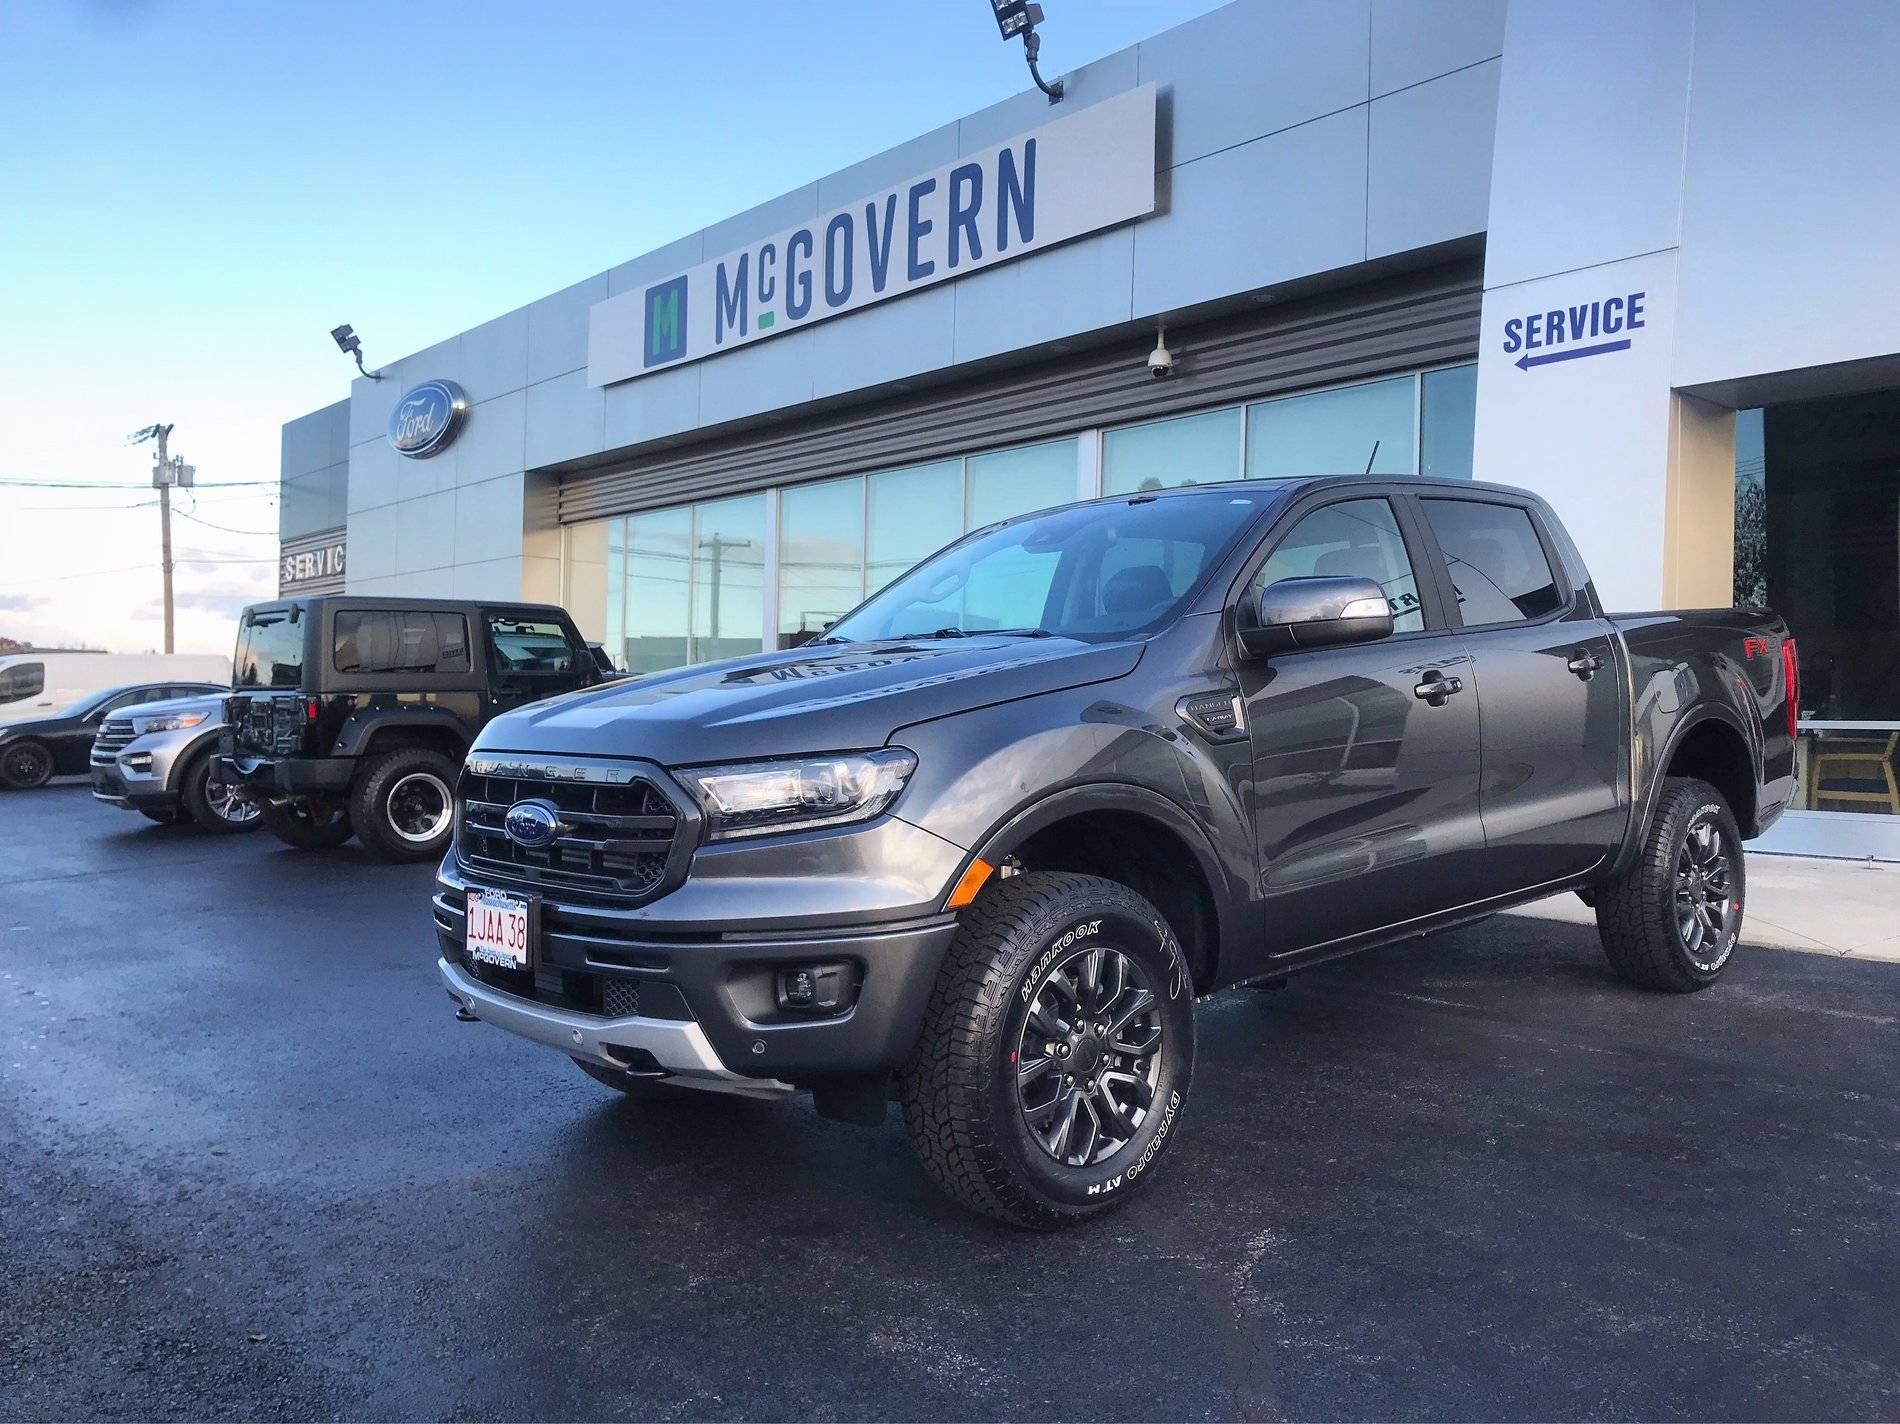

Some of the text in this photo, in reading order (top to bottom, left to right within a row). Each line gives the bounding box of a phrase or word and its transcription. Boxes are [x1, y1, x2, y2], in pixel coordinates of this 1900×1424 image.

[715, 137, 1037, 346] McGOVERN
[1503, 291, 1646, 354] SERVICE
[396, 397, 436, 442] Ford
[285, 545, 344, 583] SERVIC
